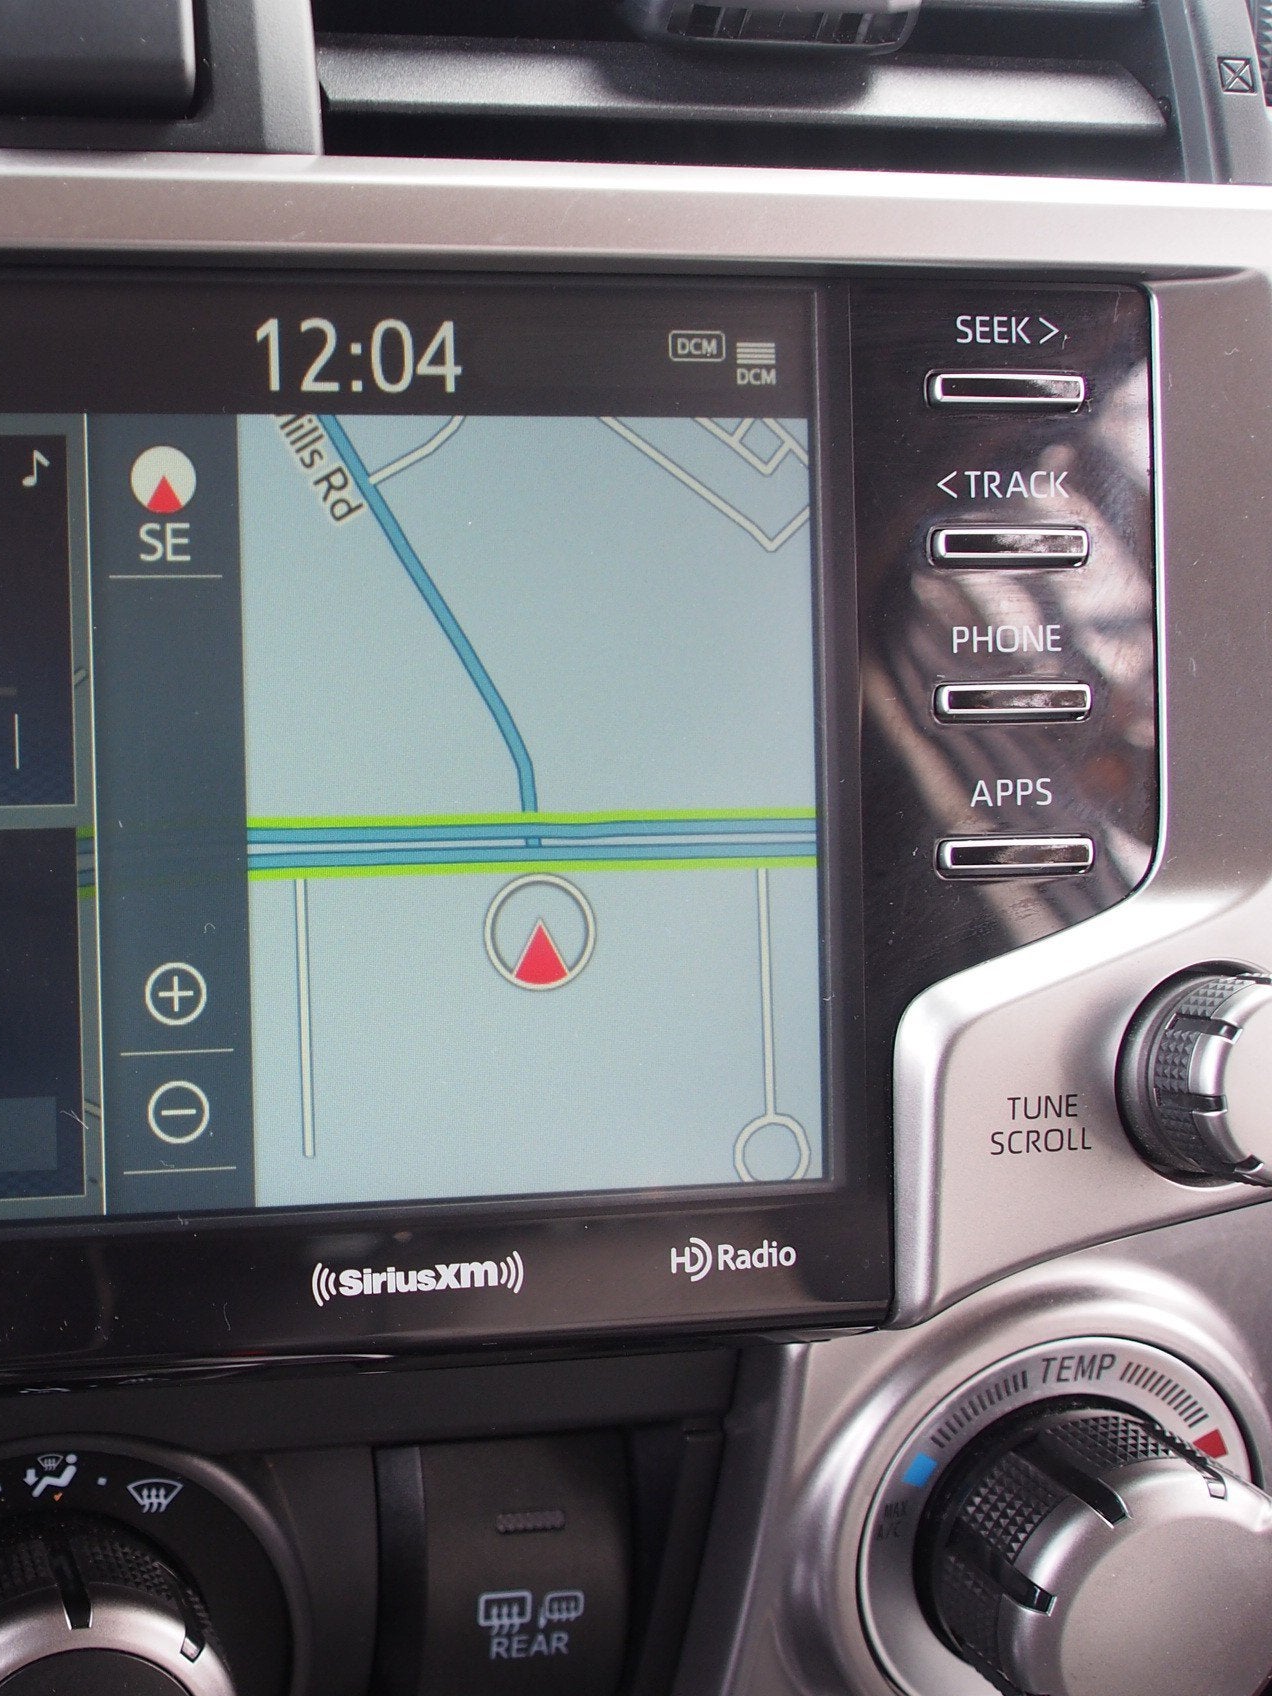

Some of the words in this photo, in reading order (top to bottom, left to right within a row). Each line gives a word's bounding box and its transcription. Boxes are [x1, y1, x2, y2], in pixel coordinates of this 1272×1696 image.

[254, 317, 463, 394] 12:04
[677, 337, 718, 356] DCM
[736, 367, 777, 386] DCM
[313, 465, 364, 522] Rd
[138, 522, 192, 563] SE
[951, 624, 1063, 654] PHONE
[970, 777, 1054, 807] APPS
[1007, 1093, 1079, 1121] TUNE
[989, 1127, 1093, 1156] SCROLL
[717, 1240, 797, 1271] Radio
[1039, 1353, 1116, 1385] TEMP
[490, 1631, 569, 1660] REAR
